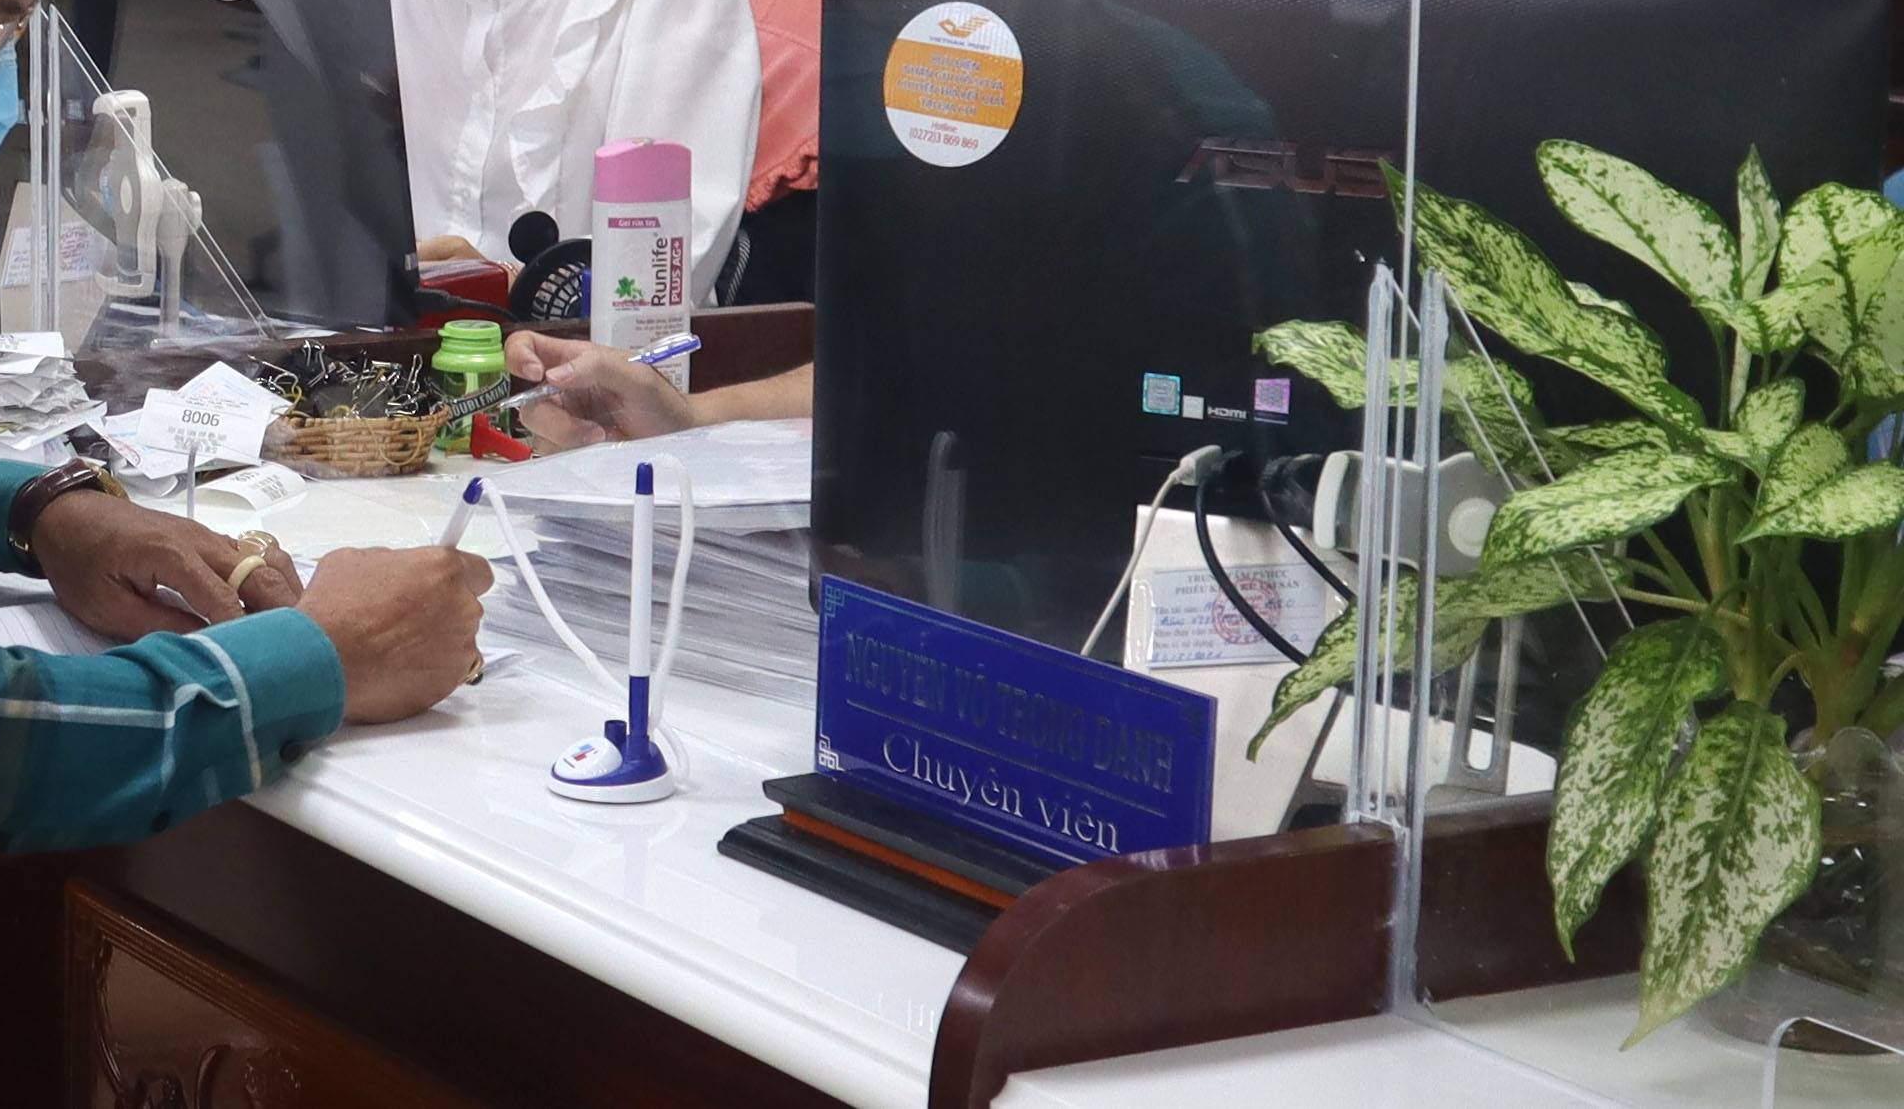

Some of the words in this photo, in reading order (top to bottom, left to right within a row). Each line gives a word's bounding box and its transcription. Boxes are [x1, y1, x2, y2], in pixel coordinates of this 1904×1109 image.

[1175, 136, 1392, 199] ASUS
[650, 237, 668, 307] Runlife
[671, 240, 681, 267] AG+
[671, 270, 681, 303] PLUS
[882, 732, 1024, 818] Chuyên
[1038, 794, 1120, 854] viên
